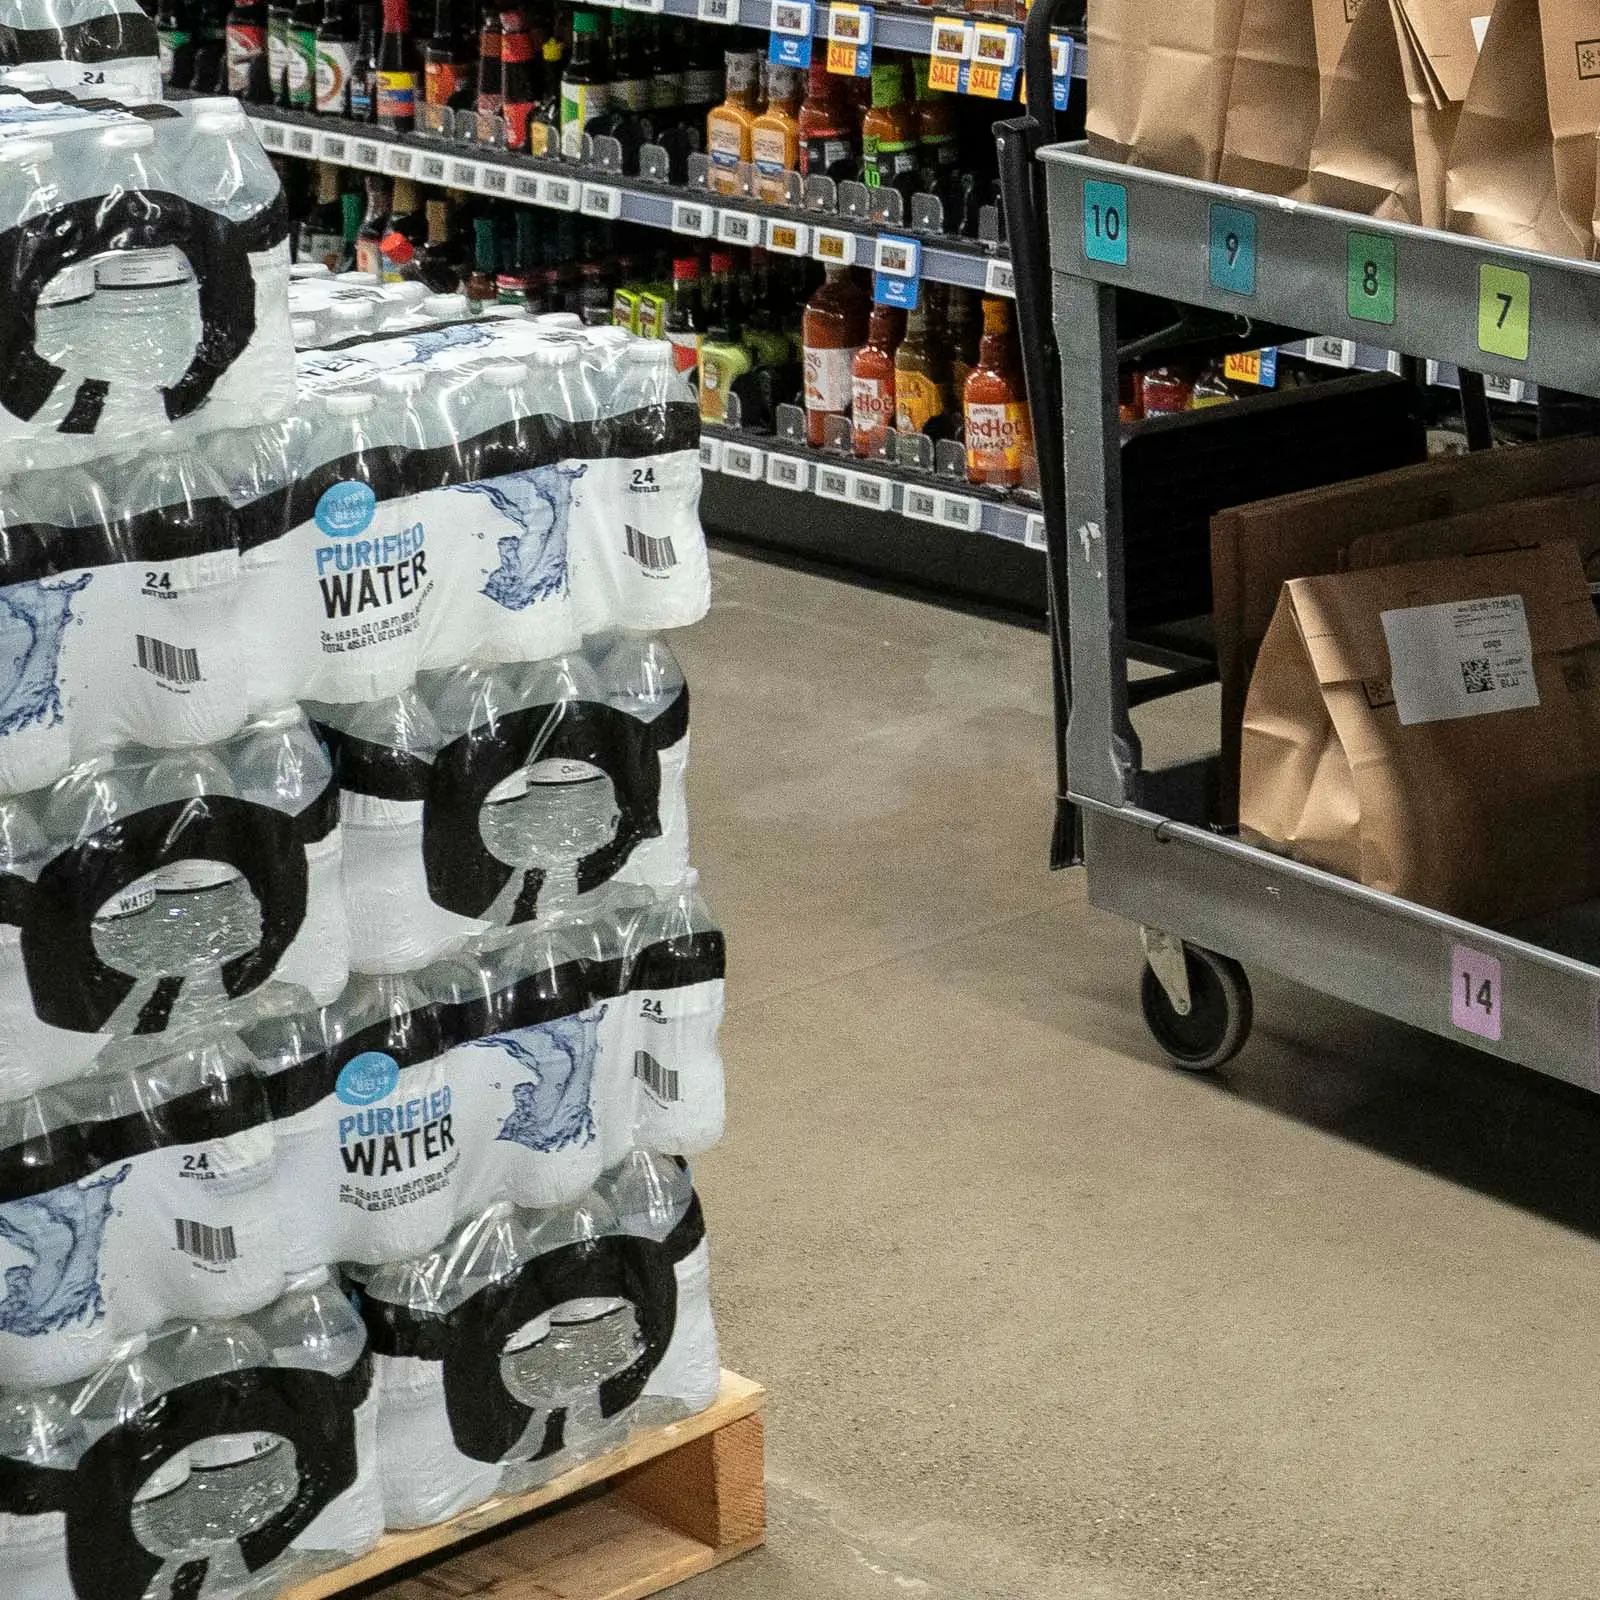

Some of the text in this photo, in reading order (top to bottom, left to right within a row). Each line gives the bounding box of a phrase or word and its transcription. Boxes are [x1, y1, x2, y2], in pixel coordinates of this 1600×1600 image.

[1091, 203, 1120, 242] 10
[1224, 233, 1240, 270] 9
[1362, 260, 1379, 297] 8
[1496, 292, 1513, 329] 7
[632, 467, 654, 485] 24
[314, 521, 425, 576] PURIFIED
[141, 588, 178, 600] BOTTLES
[144, 572, 172, 590] 24
[319, 550, 431, 618] WATER
[1458, 969, 1494, 1015] 14
[337, 1085, 454, 1144] PURIFIED
[182, 1153, 209, 1172] 24
[339, 1113, 455, 1178] WATER
